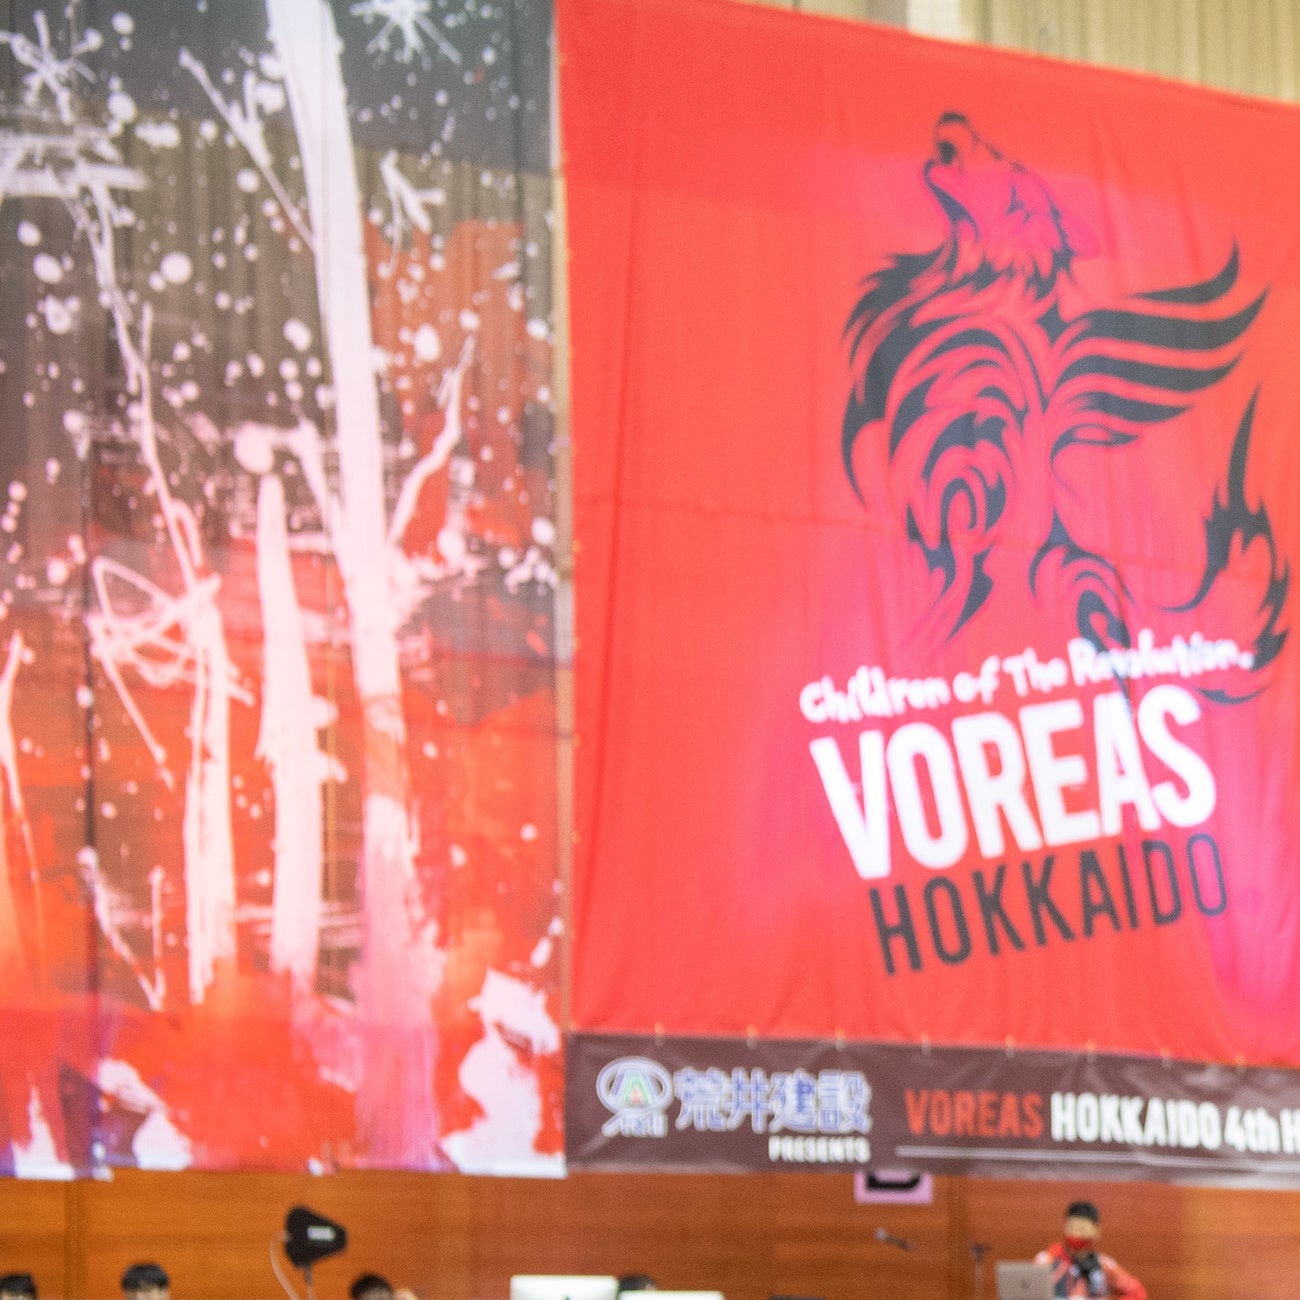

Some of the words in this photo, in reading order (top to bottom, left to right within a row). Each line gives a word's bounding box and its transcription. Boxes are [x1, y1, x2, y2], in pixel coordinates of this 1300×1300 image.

[953, 655, 1000, 704] of
[1002, 647, 1067, 696] The
[809, 684, 1217, 879] VOREAS
[869, 833, 1228, 976] HOKKAIDO
[906, 1088, 1044, 1138] VOREAS
[1050, 1092, 1221, 1150] HOKKAIDO
[1224, 1105, 1279, 1154] 4th
